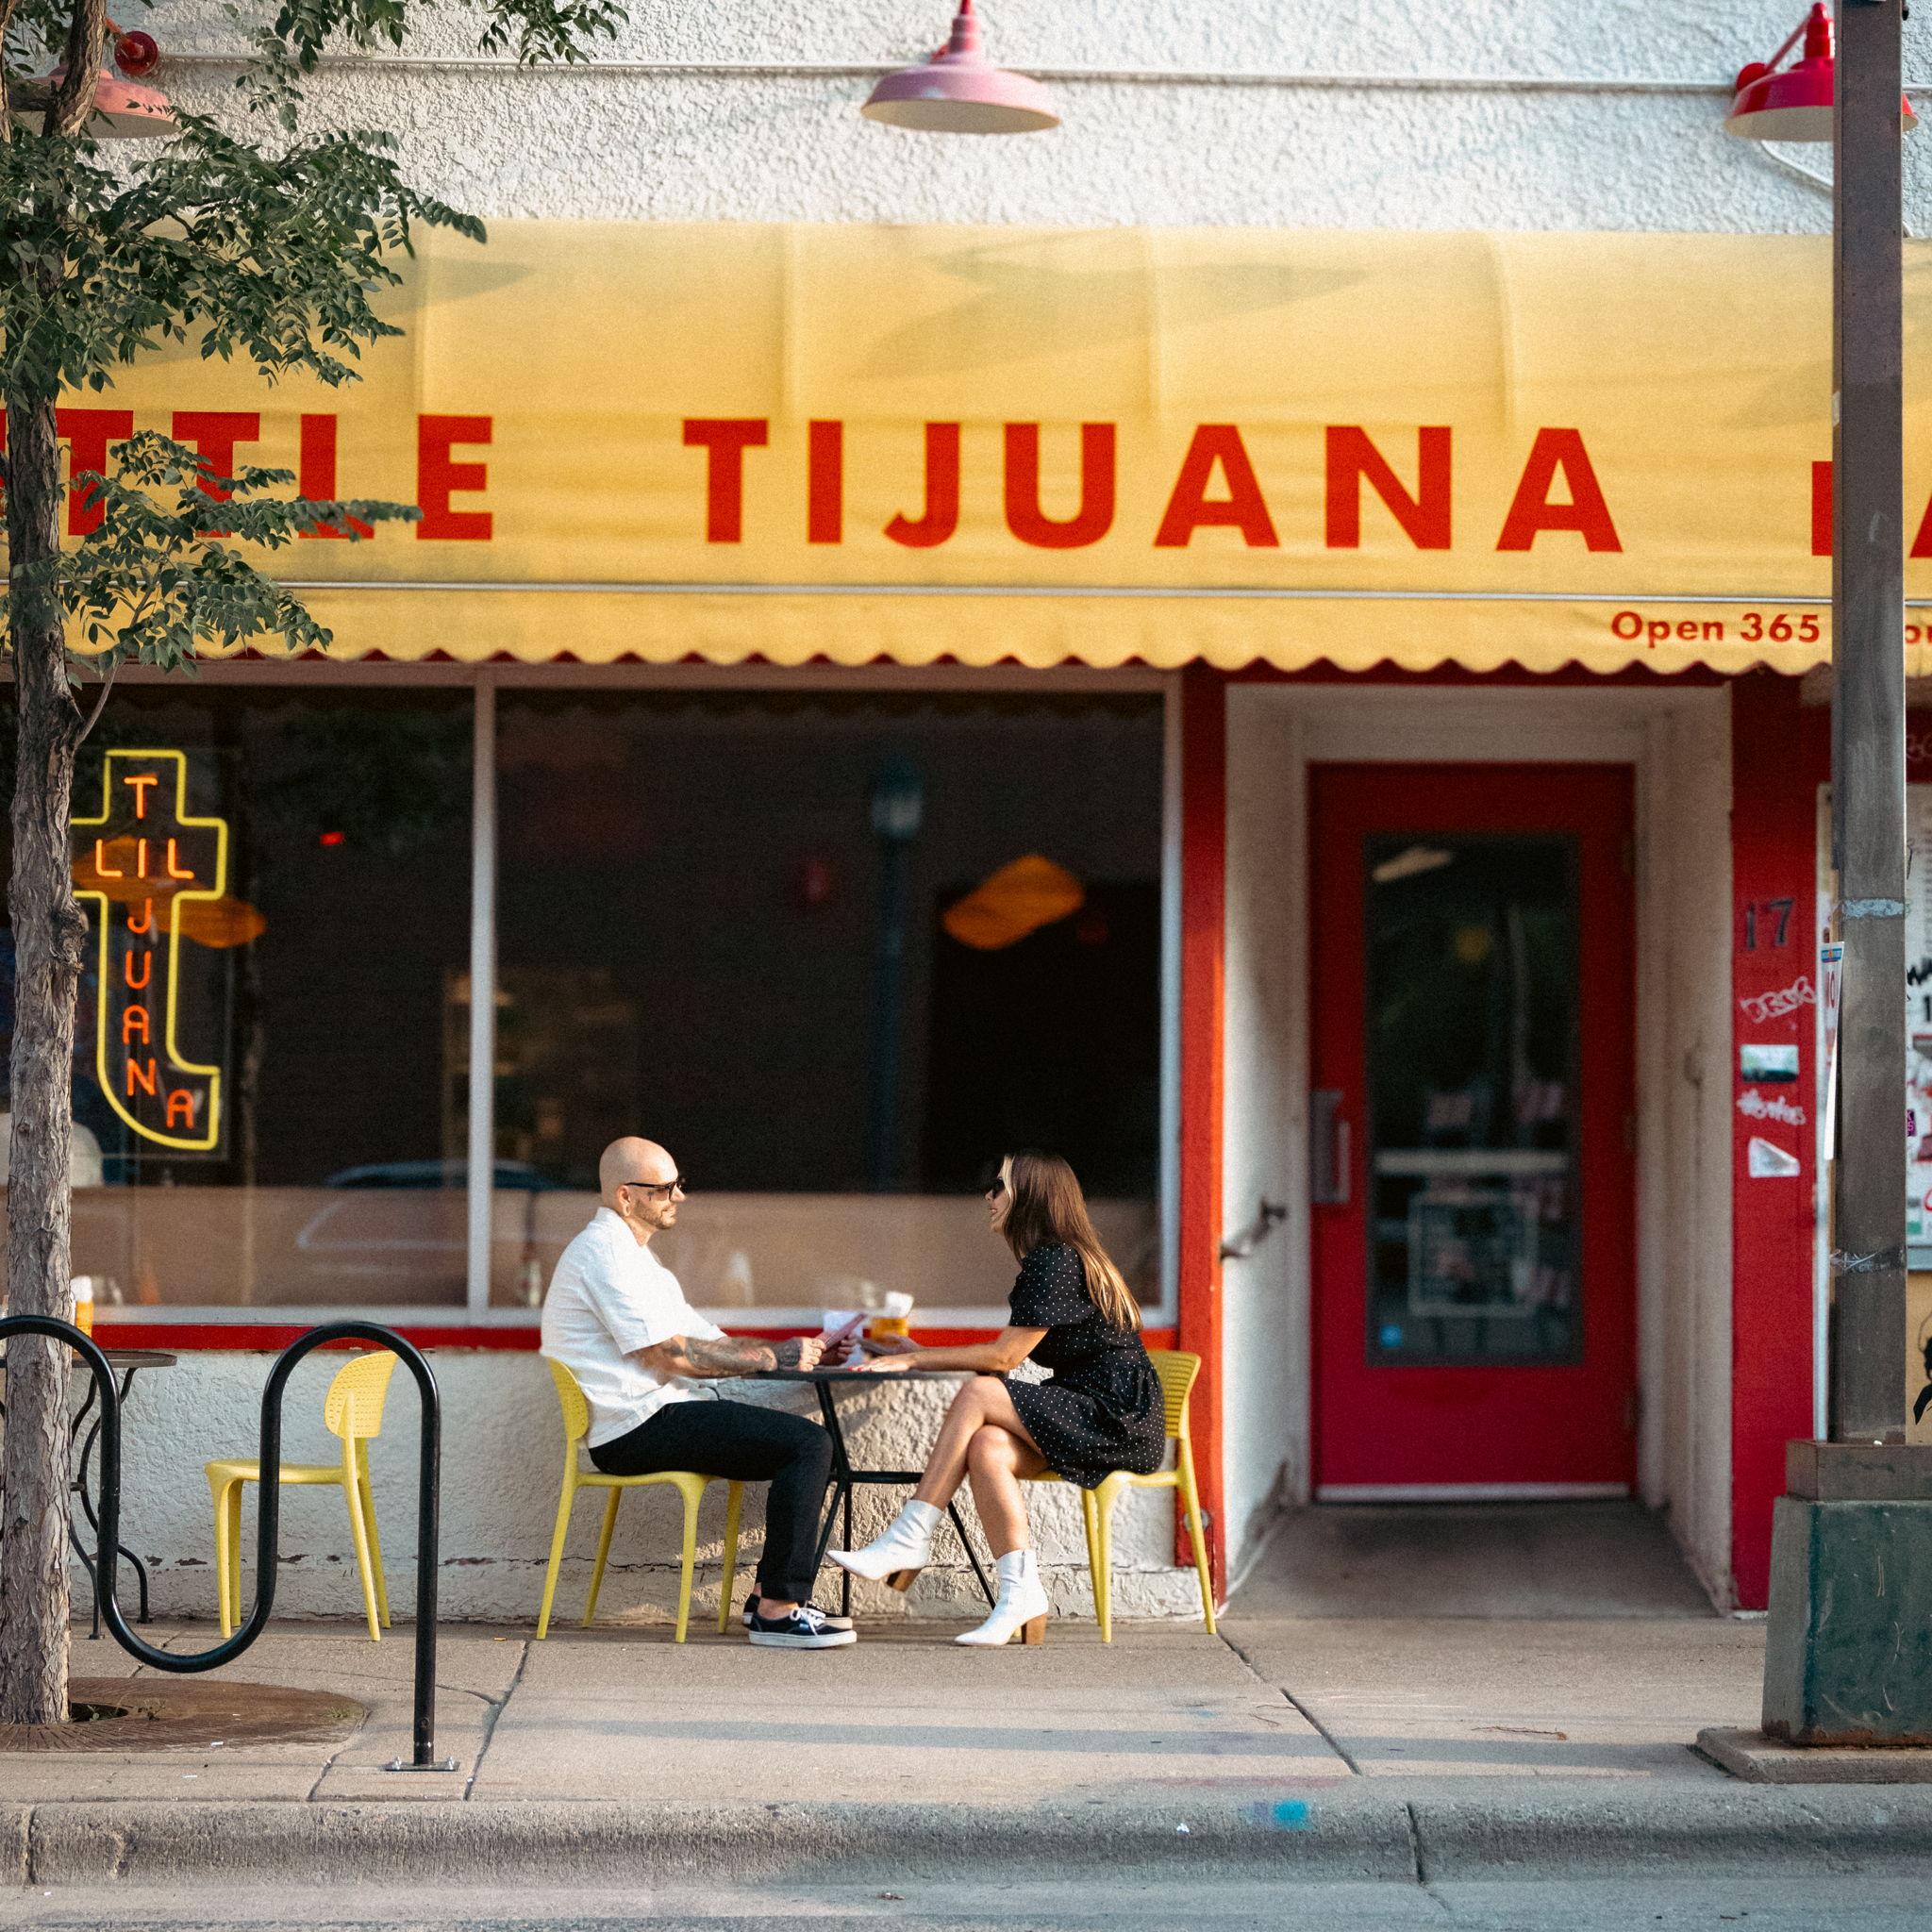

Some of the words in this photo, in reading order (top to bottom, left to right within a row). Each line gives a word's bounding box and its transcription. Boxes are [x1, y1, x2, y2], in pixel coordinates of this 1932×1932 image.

[0, 408, 492, 541] TTLE
[682, 419, 1624, 553] TIJUANA
[1611, 610, 1724, 649] Open
[1740, 613, 1821, 643] 365
[123, 774, 194, 1129] TIJUANA
[1745, 897, 1796, 952] 17
